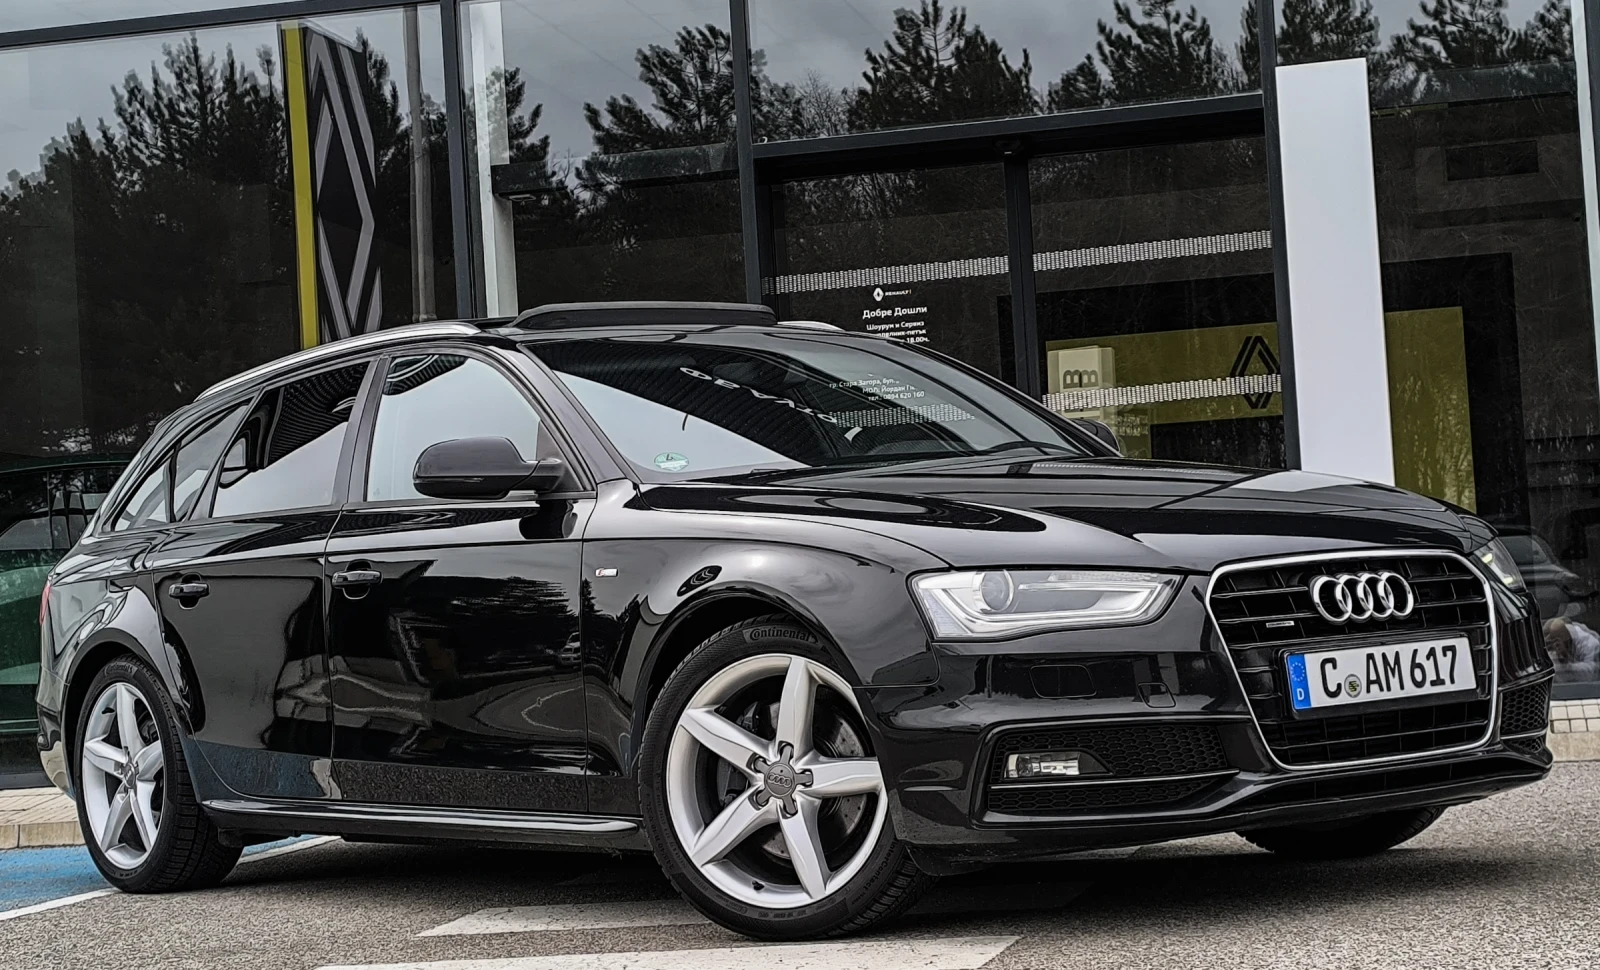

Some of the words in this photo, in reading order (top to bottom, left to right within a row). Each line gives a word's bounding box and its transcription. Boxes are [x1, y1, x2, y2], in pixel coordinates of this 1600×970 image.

[862, 308, 892, 319] Добре
[894, 306, 927, 316] Дошли
[900, 321, 925, 329] Сервиз
[839, 380, 857, 388] Стара
[858, 379, 882, 388] Загора,
[900, 391, 912, 399] 620
[750, 626, 810, 641] Continental
[1320, 657, 1342, 698] C
[1366, 650, 1405, 694] AM
[1410, 644, 1457, 689] 617
[1297, 688, 1305, 701] D
[864, 840, 899, 891] interContact
